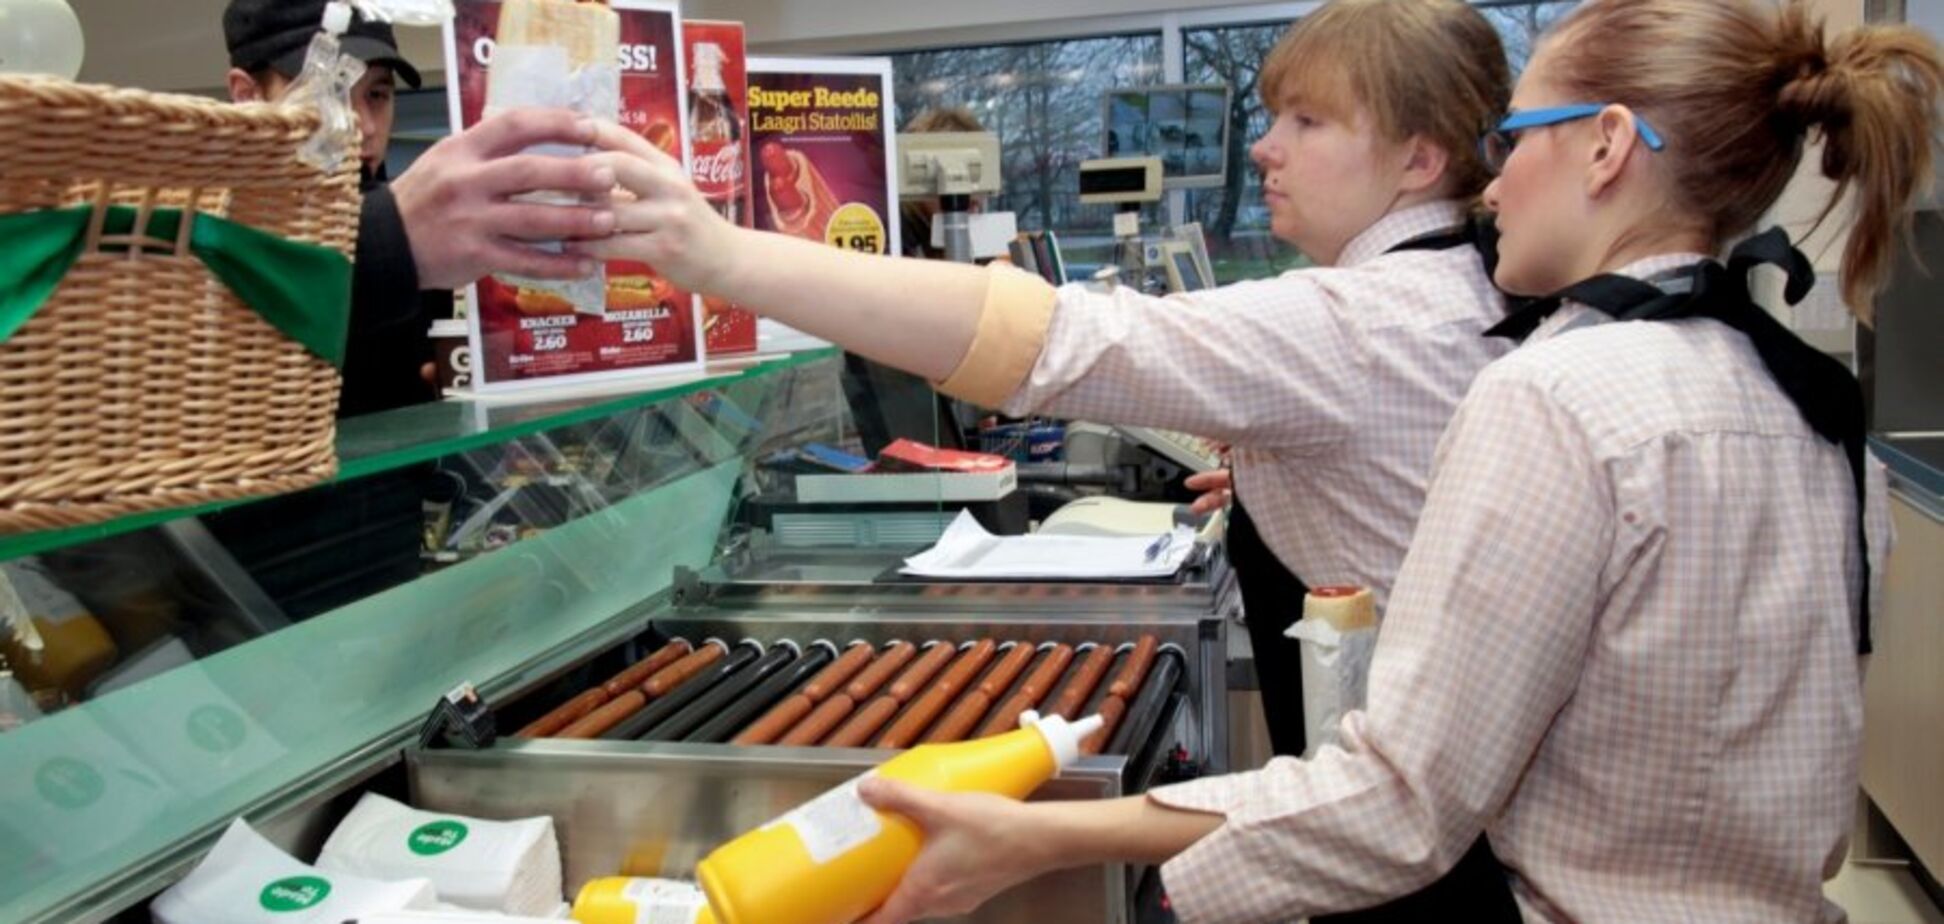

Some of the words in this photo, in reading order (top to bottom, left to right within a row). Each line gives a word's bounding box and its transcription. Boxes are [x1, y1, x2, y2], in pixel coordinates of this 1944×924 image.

[748, 86, 812, 111] Super
[814, 87, 879, 108] Reede
[752, 112, 807, 134] Laagri
[809, 111, 878, 131] Statoilis!
[534, 335, 567, 350] 2.60
[623, 328, 654, 342] 2.60
